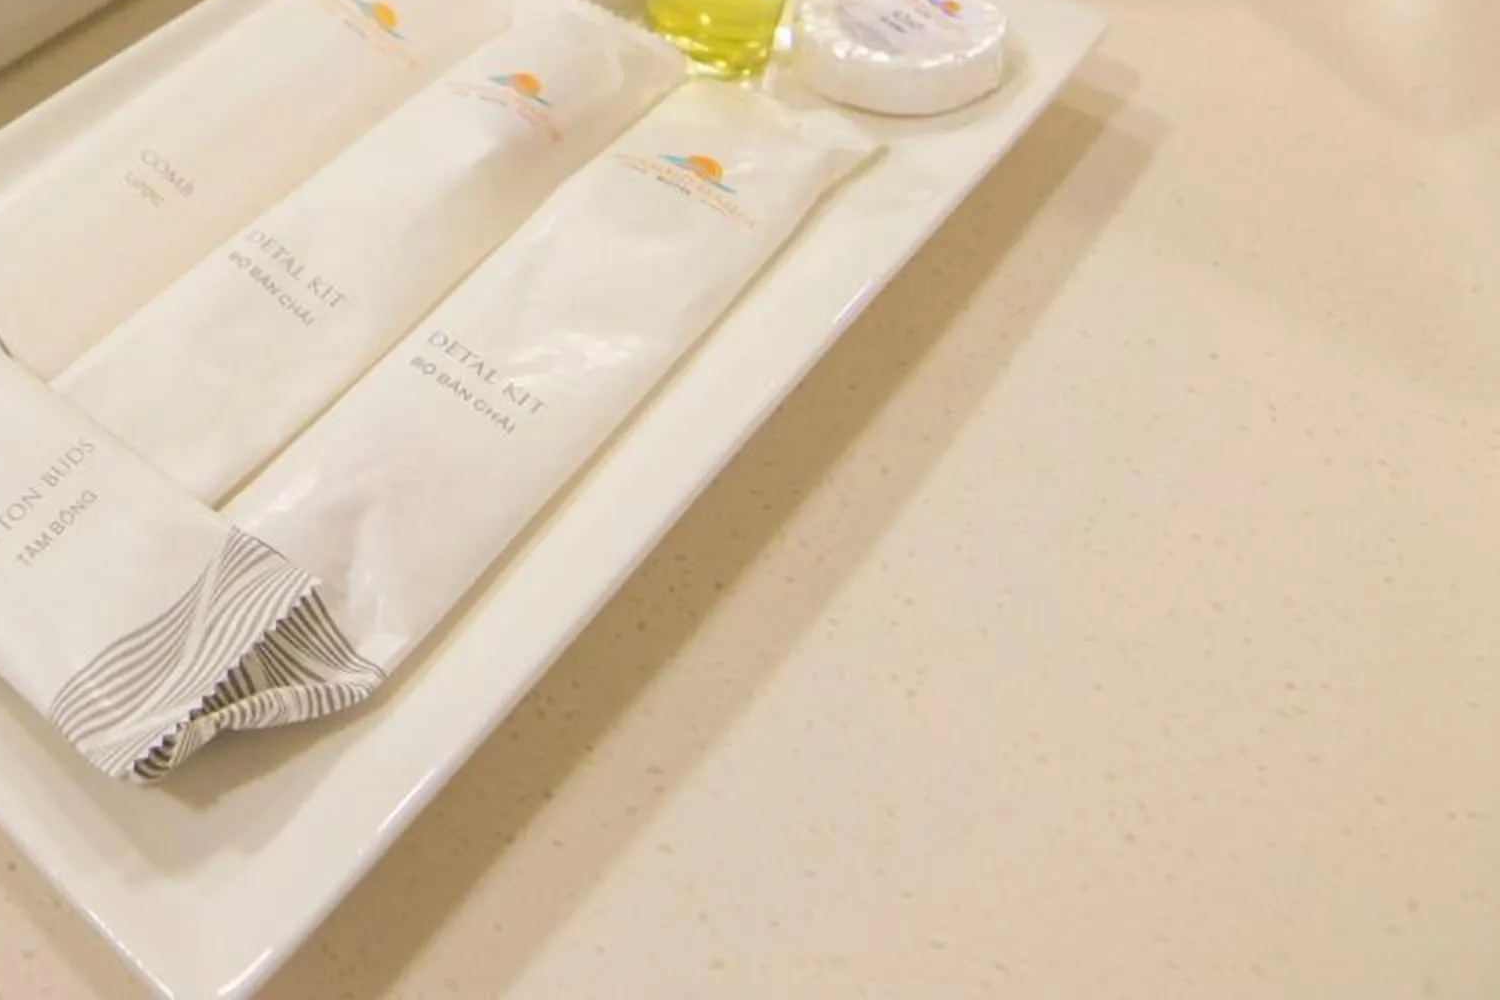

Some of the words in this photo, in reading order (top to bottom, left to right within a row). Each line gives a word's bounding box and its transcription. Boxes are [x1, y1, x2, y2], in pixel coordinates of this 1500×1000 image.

[246, 230, 306, 281] DETAL
[307, 275, 350, 308] KIT
[427, 331, 500, 385] DETAL
[501, 382, 550, 415] KIT
[41, 435, 97, 488] BUDS
